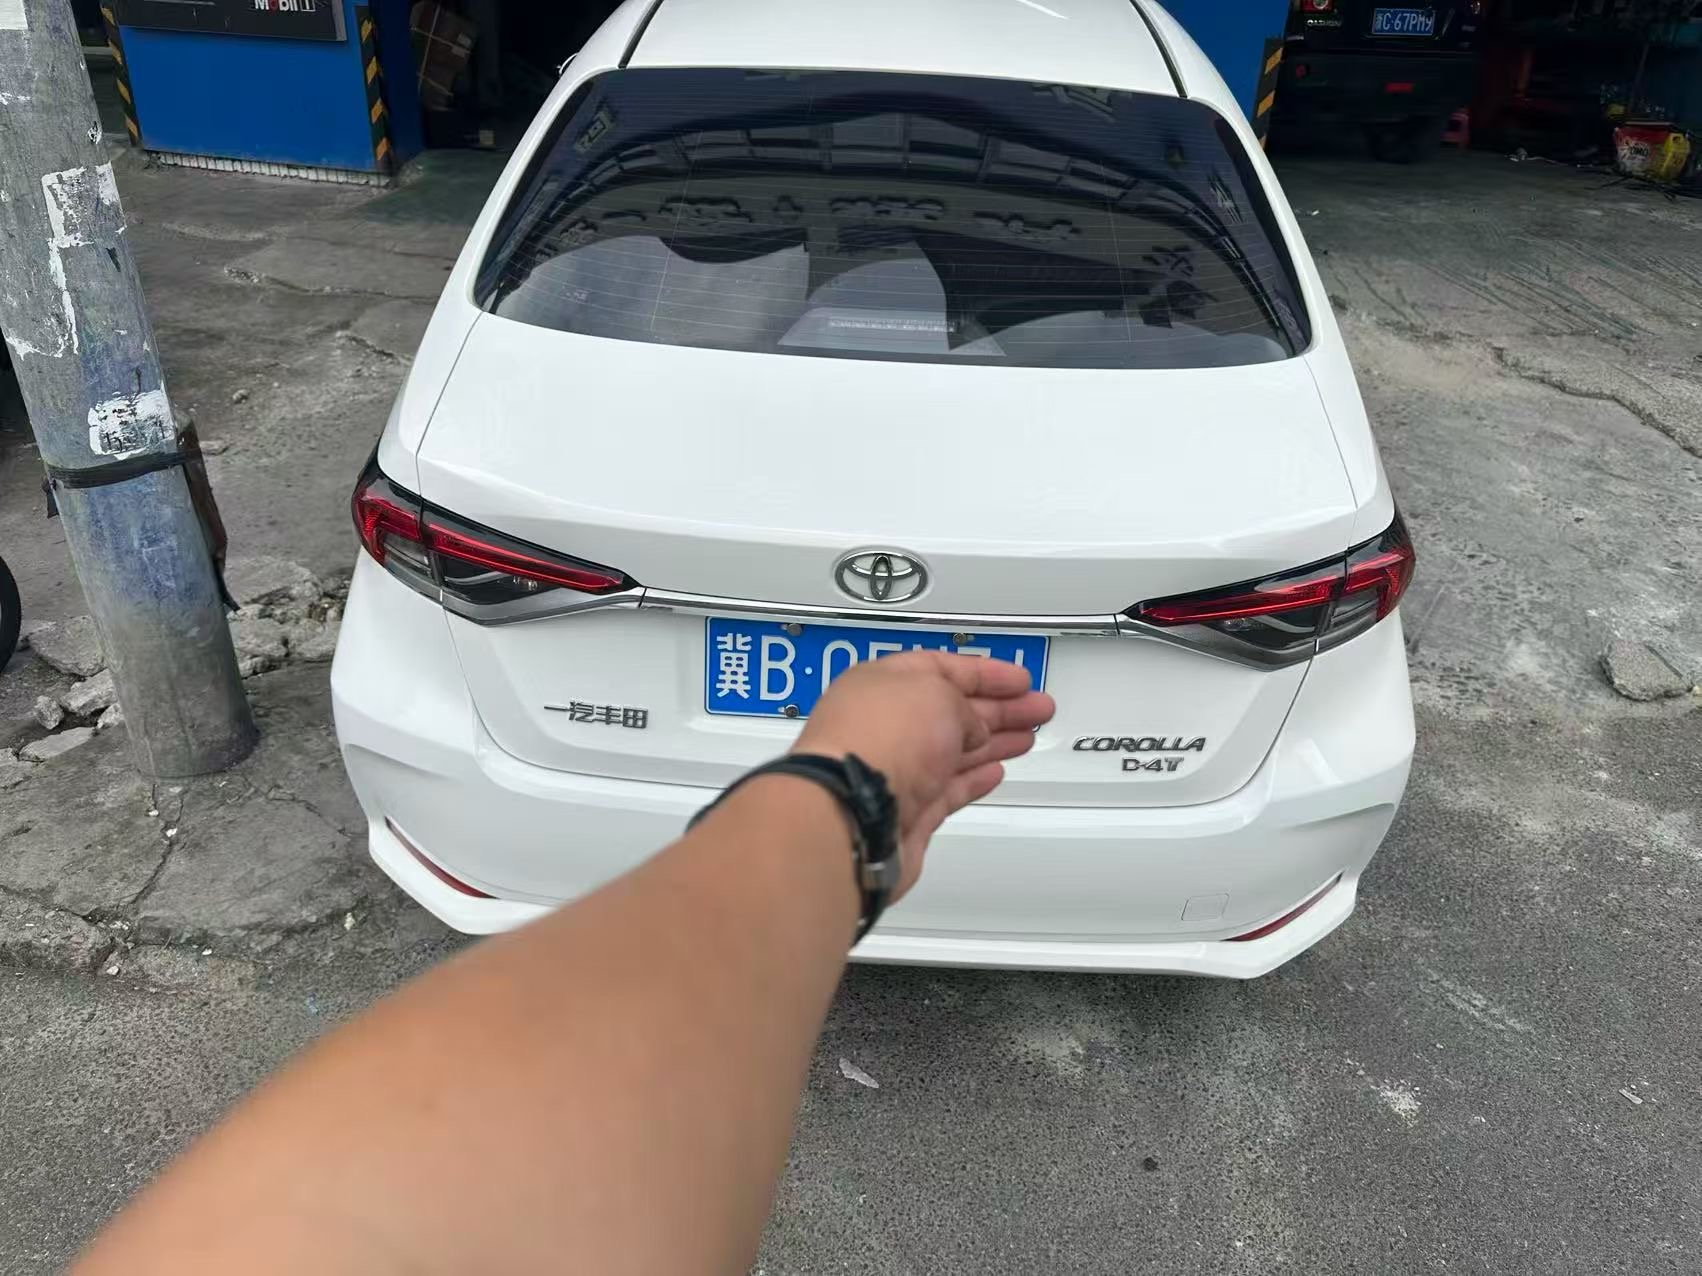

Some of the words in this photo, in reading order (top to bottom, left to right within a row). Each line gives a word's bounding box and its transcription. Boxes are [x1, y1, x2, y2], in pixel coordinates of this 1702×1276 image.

[544, 700, 648, 729] 一汽丰田
[1072, 736, 1207, 753] COROLLA
[1122, 756, 1184, 772] D-4T
